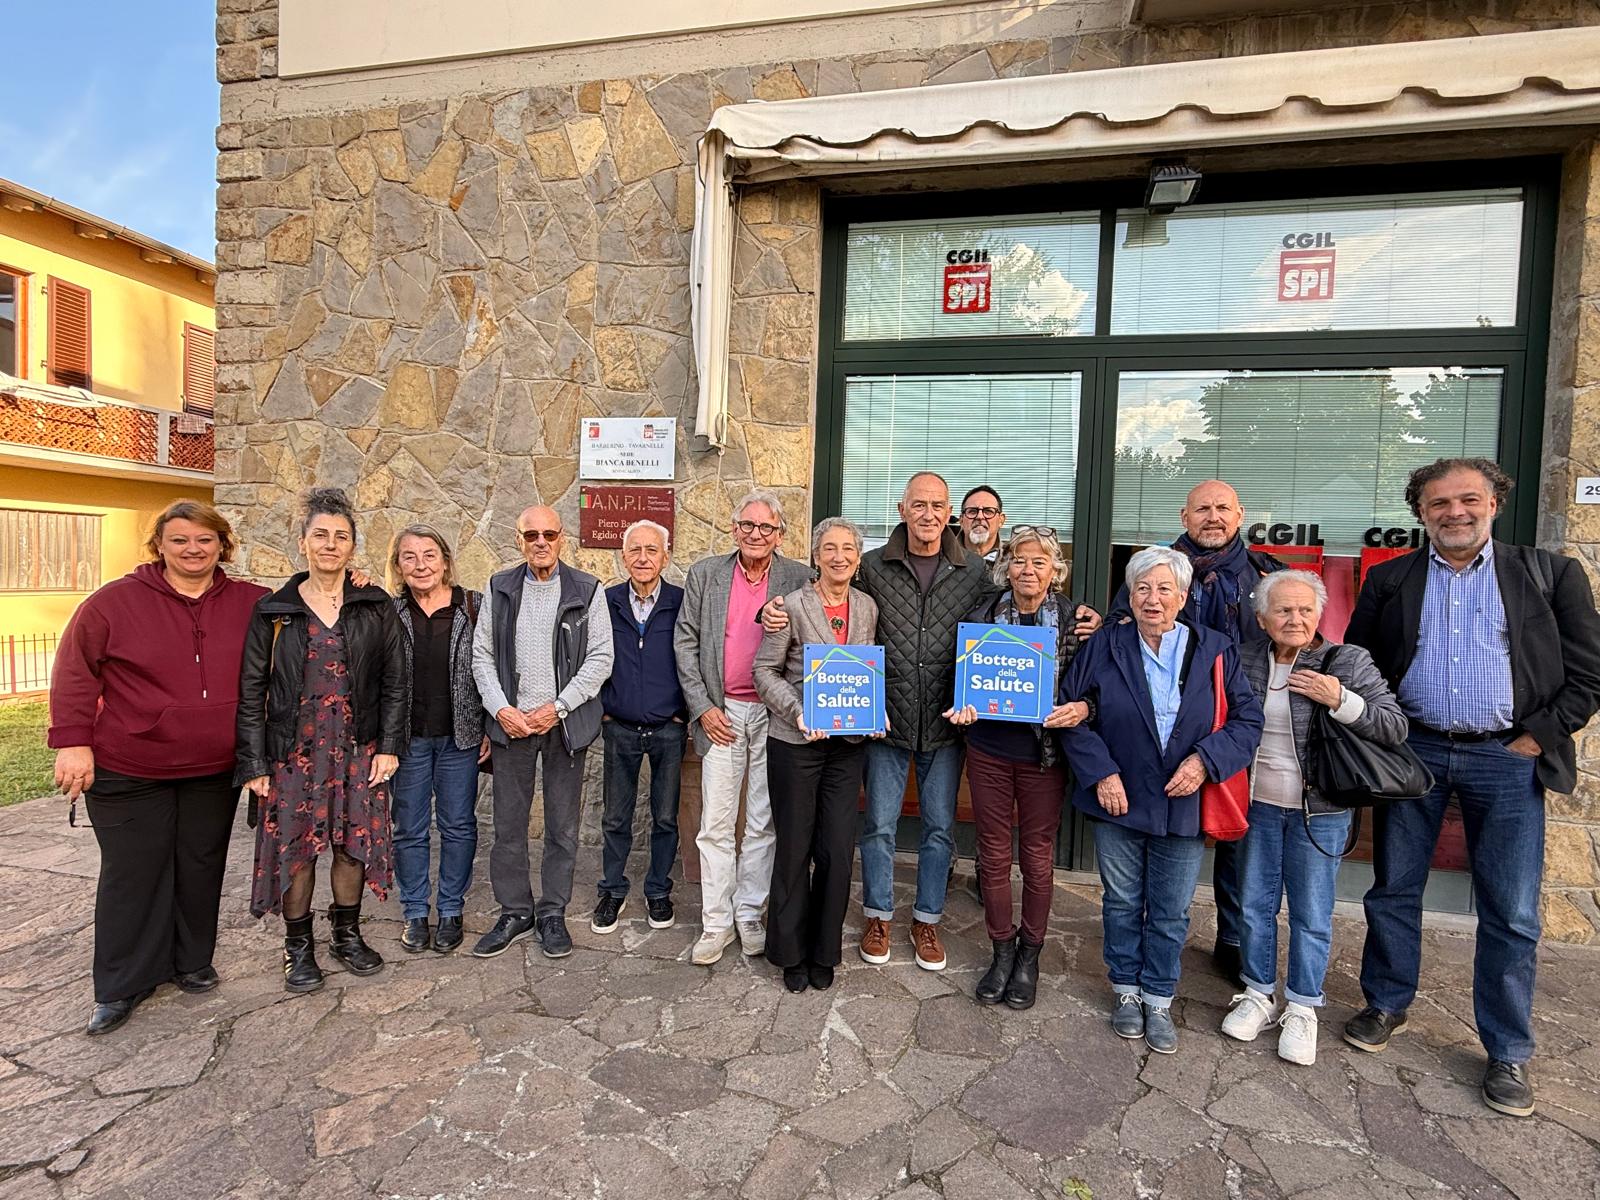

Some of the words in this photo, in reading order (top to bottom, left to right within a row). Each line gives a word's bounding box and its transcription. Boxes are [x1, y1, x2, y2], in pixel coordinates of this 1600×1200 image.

[1282, 233, 1335, 248] CGIL
[946, 249, 991, 264] CGIL
[1284, 270, 1330, 298] SPI
[947, 283, 985, 309] SPI
[626, 459, 659, 467] BENELLI
[592, 494, 645, 511] A.N.P.I.
[598, 519, 619, 528] Piero
[592, 530, 618, 541] Egidio
[1248, 522, 1324, 546] CGIL
[972, 652, 1035, 671] Bottega
[817, 672, 869, 687] Bottega
[998, 668, 1017, 678] della
[840, 686, 856, 694] della
[971, 674, 1035, 693] Salute
[817, 693, 871, 708] Salute
